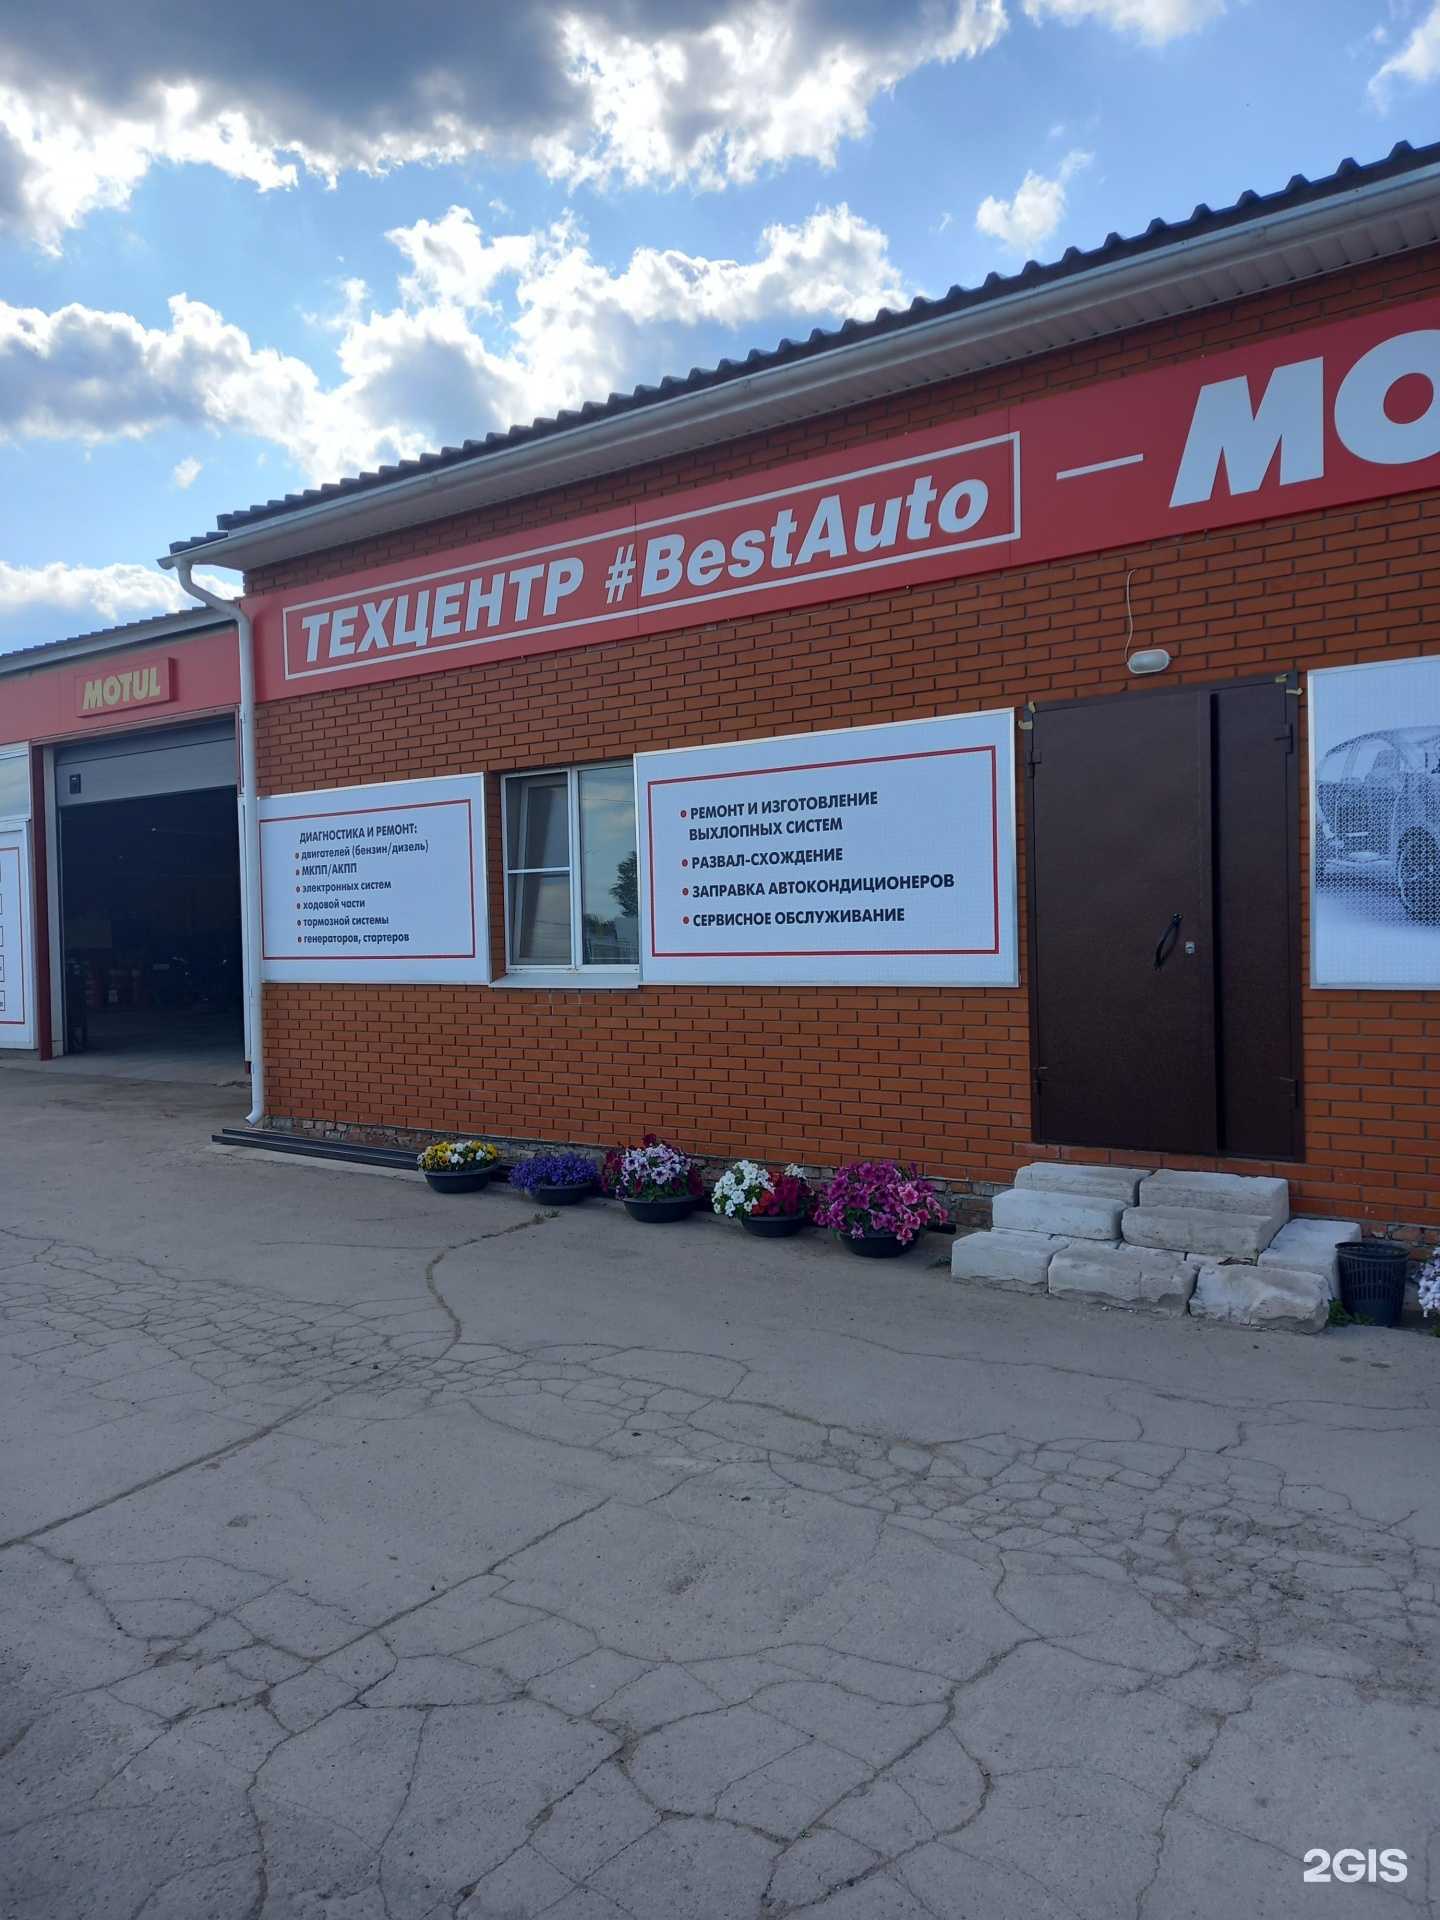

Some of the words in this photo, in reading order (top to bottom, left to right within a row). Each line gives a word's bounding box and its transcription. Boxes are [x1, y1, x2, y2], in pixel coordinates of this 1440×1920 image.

[302, 557, 584, 662] ТЕХЦЕНТР
[605, 475, 989, 605] #BestAuto
[82, 667, 161, 709] MOTUL
[690, 803, 745, 819] РЕМОНТ
[747, 801, 758, 815] И
[761, 791, 878, 814] ИЗГОТОВЛЕНИЕ
[299, 827, 365, 844] ДИАГНОСТИКА
[367, 826, 374, 838] И
[376, 823, 418, 836] РЕМОНТ:
[689, 821, 782, 841] ВЫХЛОПНЫХ
[786, 817, 843, 834] СИСТЕМ
[301, 846, 350, 860] двигателей
[352, 839, 429, 858] (бензин/дизель)
[691, 847, 843, 869] РАЗВАЛ-СХОЖДЕНИЕ
[301, 862, 357, 877] МКПП/АКПП
[302, 882, 359, 894] электронных
[360, 880, 392, 890] систем
[692, 883, 765, 898] ЗАПРАВКА
[768, 873, 955, 895] АВТОКОНДИЦИОНЕРОВ
[303, 898, 340, 910] ходовой
[341, 899, 366, 908] части
[303, 915, 350, 928] тормозной
[351, 916, 389, 925] системы
[692, 911, 772, 927] СЕРВИСНОЕ
[774, 908, 905, 925] ОБСЛУЖИВАНИЕ
[303, 934, 361, 945] генераторов,
[362, 933, 410, 944] стартеров
